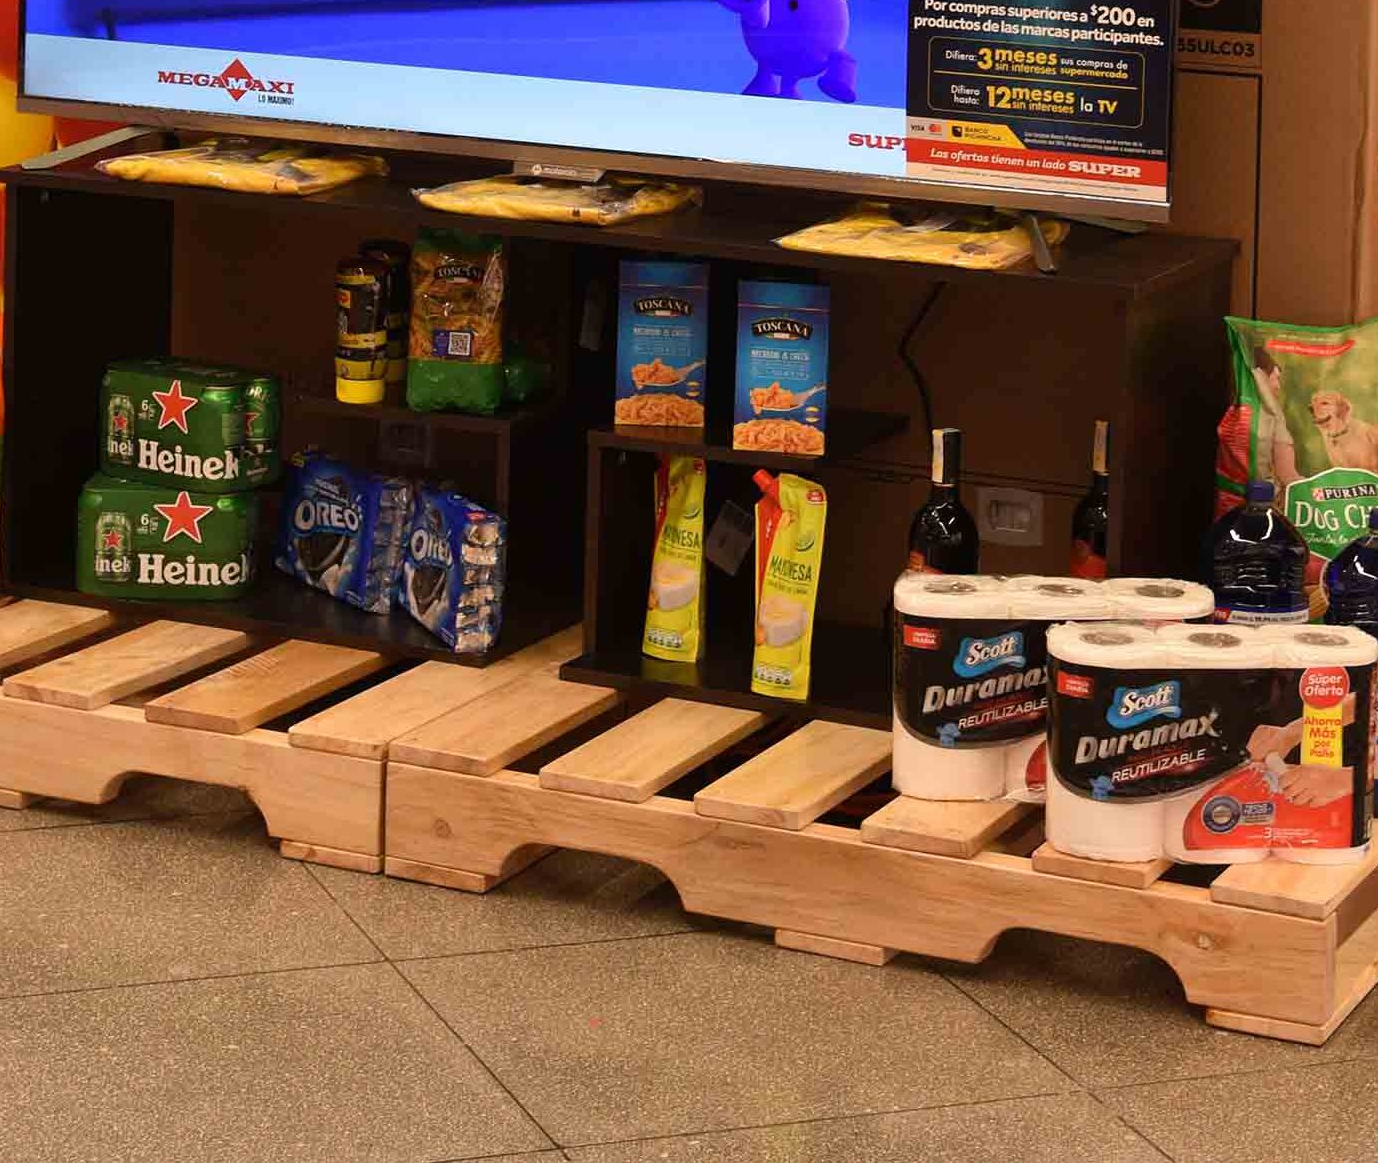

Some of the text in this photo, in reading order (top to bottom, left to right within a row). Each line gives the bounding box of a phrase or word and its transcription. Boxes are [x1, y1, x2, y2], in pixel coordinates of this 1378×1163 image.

[949, 1, 1006, 19] compras
[1008, 6, 1078, 23] superiores
[1079, 12, 1088, 22] a
[1090, 4, 1136, 27] $200
[1137, 16, 1155, 28] en
[914, 15, 1165, 47] productos de las marcas participantes.
[977, 47, 993, 70] 3
[994, 48, 1057, 66] meses
[1060, 58, 1074, 66] sus
[1076, 59, 1114, 71] compras
[1116, 59, 1128, 70] de
[995, 62, 1128, 80] sin intereses supermercado
[158, 70, 295, 95] MEGAMAXI
[953, 95, 1075, 115] hasta: sin intereses
[987, 85, 1012, 109] 12
[1012, 86, 1075, 104] meses
[1080, 97, 1093, 113] la
[1097, 99, 1118, 115] TV
[930, 147, 1141, 178] Las ofertas tienen un lado SUPER
[638, 299, 690, 314] TOSCANA
[756, 320, 809, 337] TOSCANA
[141, 400, 149, 411] 6
[1325, 485, 1377, 499] PURINA
[140, 513, 149, 525] 6
[294, 500, 360, 532] OREO
[1295, 501, 1340, 530] DOG
[409, 528, 453, 566] OREO
[965, 636, 1016, 665] Scott
[1119, 685, 1172, 716] Scott
[1304, 685, 1344, 697] Oferta
[958, 697, 1049, 729] REUTILIZABLE
[1305, 716, 1343, 726] Ahorra
[1075, 710, 1221, 765] Duramax
[1309, 725, 1336, 738] Más
[1313, 740, 1331, 750] por
[1111, 748, 1207, 783] REUTILIZABLE
[1263, 827, 1272, 838] 3
